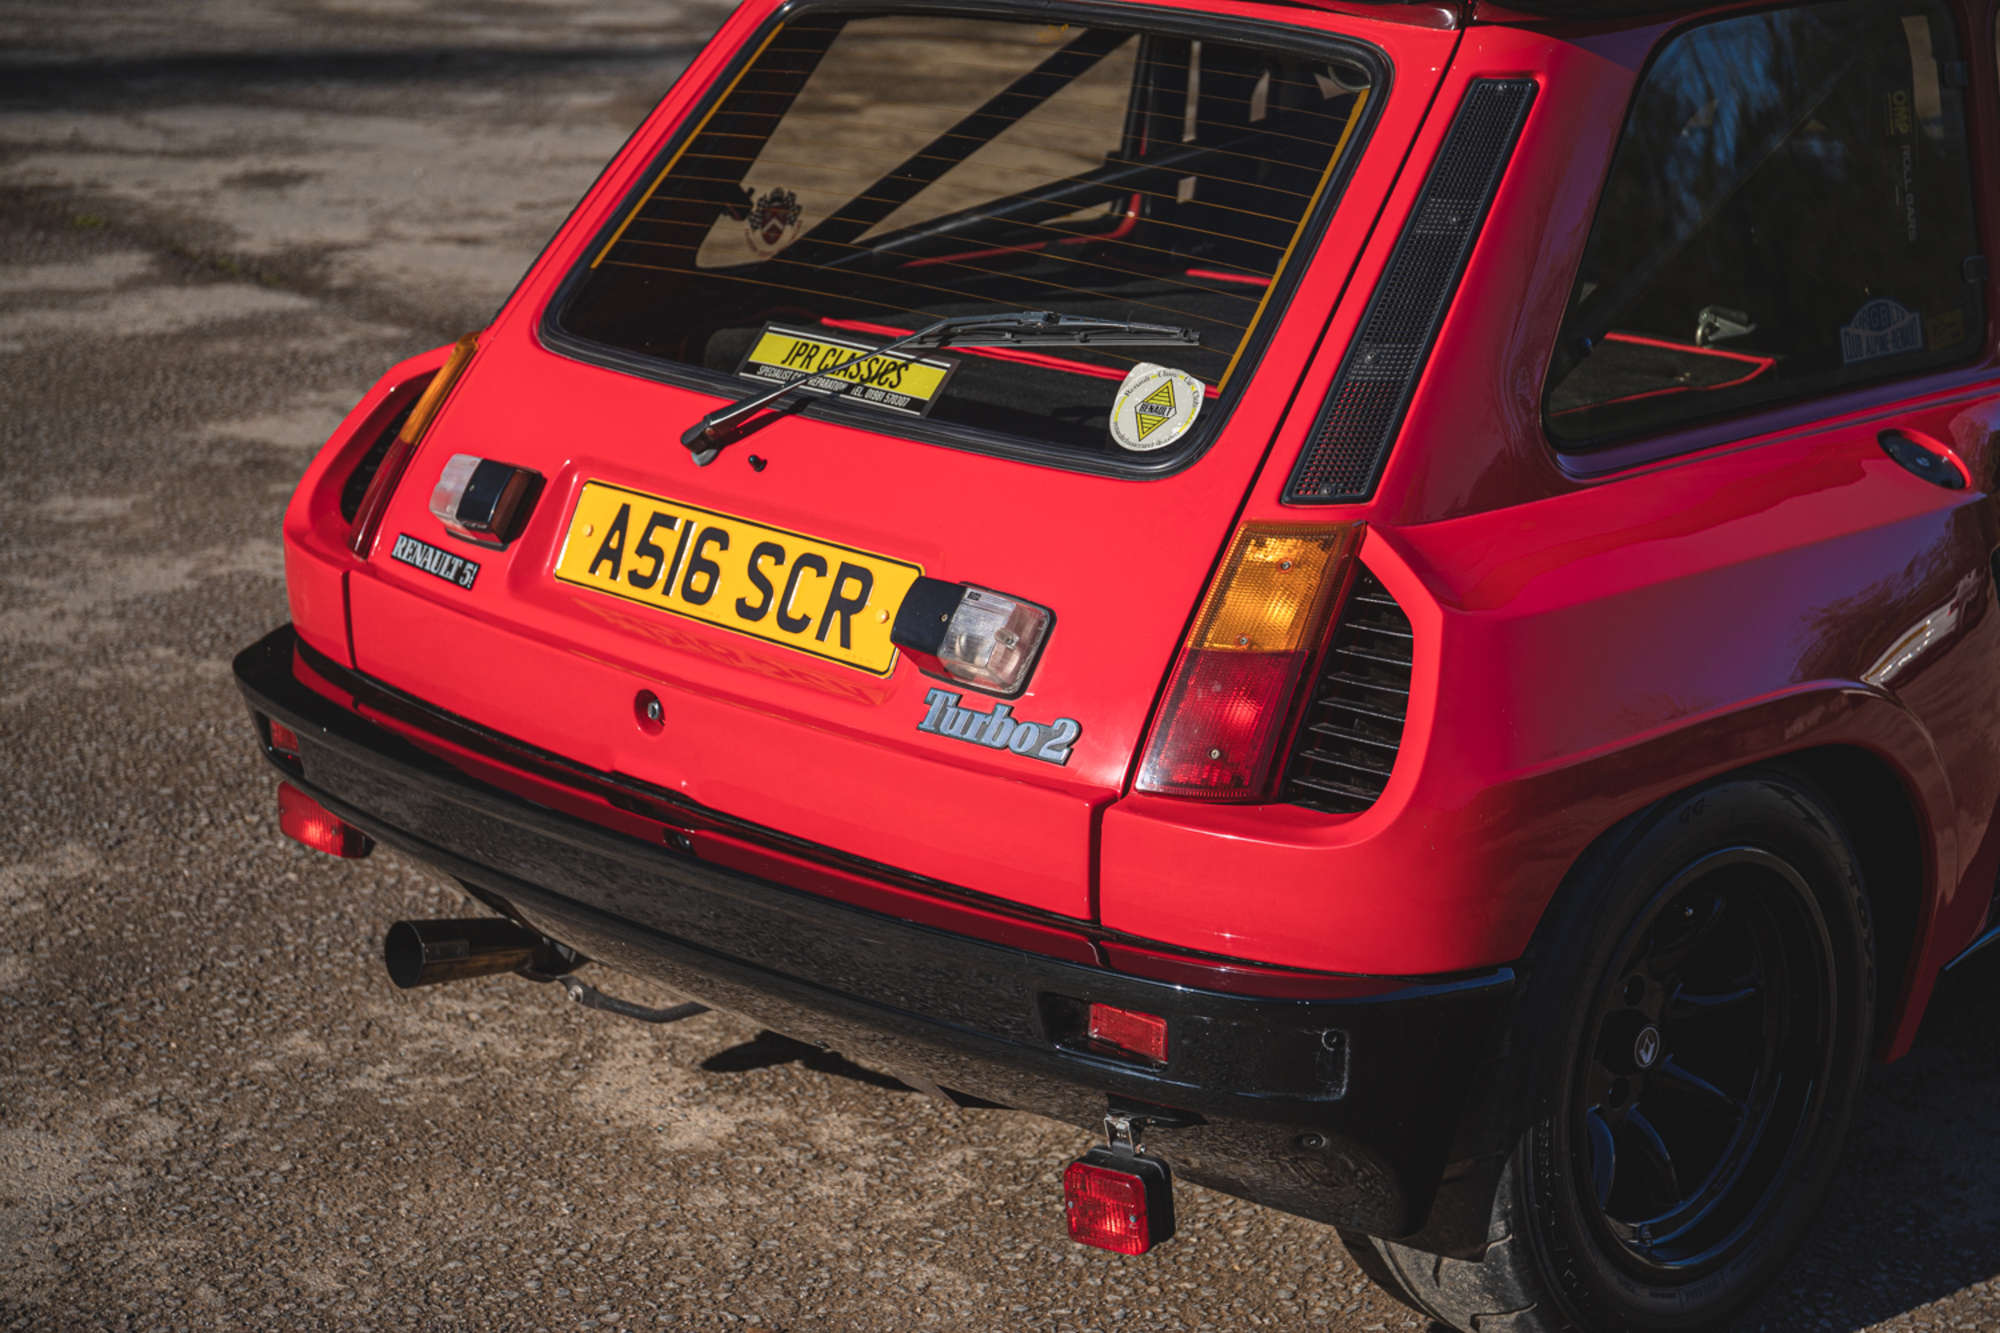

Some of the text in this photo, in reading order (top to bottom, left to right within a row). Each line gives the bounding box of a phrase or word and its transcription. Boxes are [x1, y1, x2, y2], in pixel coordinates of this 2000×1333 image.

[757, 365, 793, 381] SPECIALIST
[781, 341, 821, 371] JPR
[391, 534, 464, 582] RENAULT
[588, 503, 874, 650] A516 SCR
